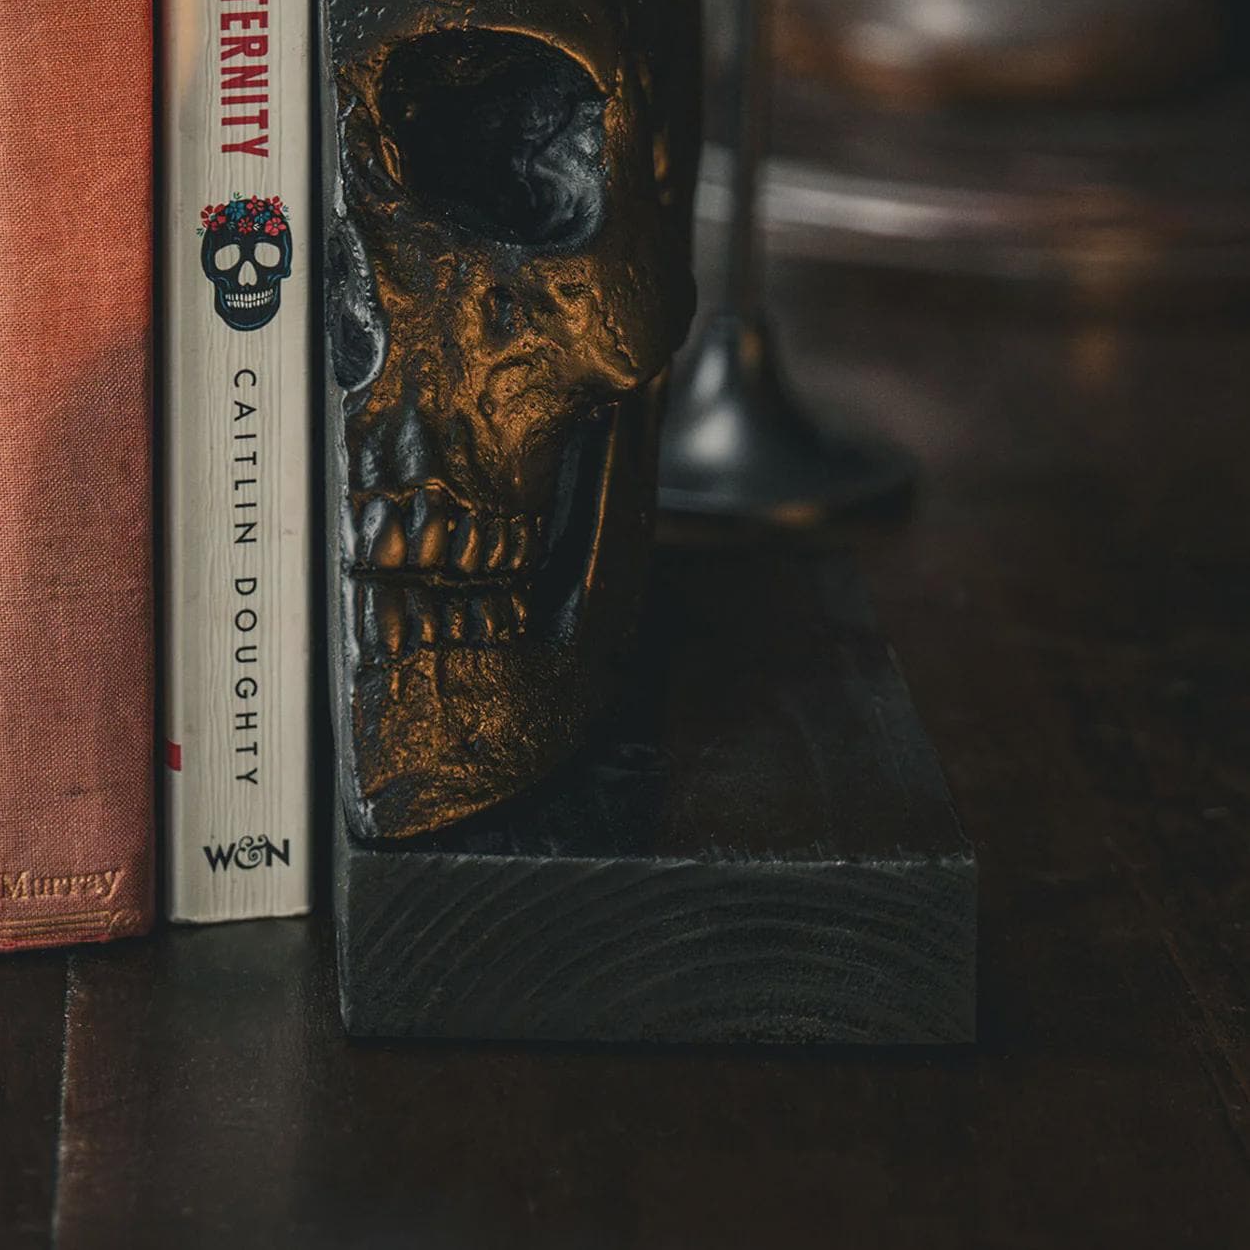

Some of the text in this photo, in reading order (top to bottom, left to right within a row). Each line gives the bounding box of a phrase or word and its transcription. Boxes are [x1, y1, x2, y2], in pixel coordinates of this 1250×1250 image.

[233, 368, 259, 786] CAITLIN DOUGHTY
[202, 834, 290, 873] W&N
[0, 866, 126, 902] Murray
